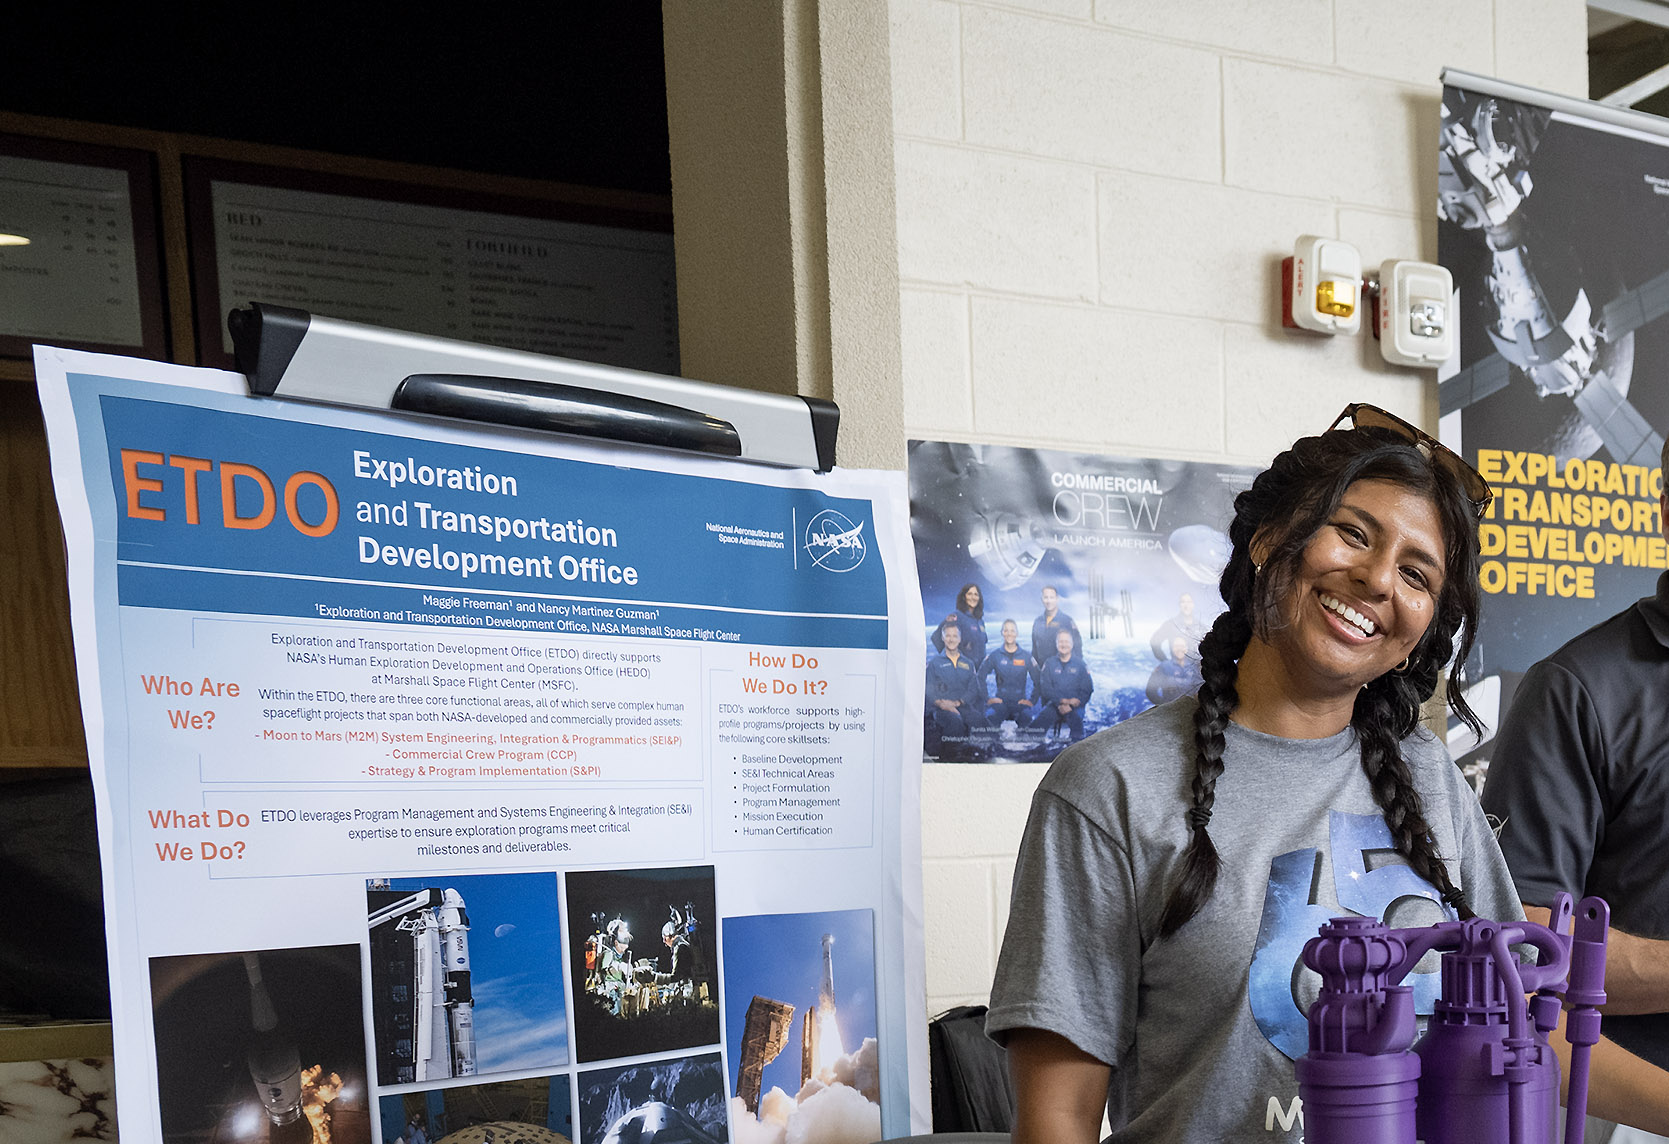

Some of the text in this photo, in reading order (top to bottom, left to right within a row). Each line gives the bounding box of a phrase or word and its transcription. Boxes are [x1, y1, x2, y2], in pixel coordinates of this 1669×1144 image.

[353, 450, 518, 496] Exploration
[1051, 472, 1162, 494] COMMERCIAL
[1478, 449, 1663, 499] EXPLORATIO
[121, 448, 340, 538] ETDO
[1052, 490, 1162, 532] CREW
[1484, 488, 1663, 534] TRANSPORT
[356, 500, 618, 547] and Transportation
[706, 522, 784, 540] National Aeronautics and
[718, 533, 785, 549] Space Administration
[812, 531, 863, 550] NASA
[1054, 534, 1163, 550] LAUNCH AMERICA
[358, 536, 638, 586] Development Office
[1479, 560, 1595, 598] OFFICE
[422, 594, 460, 609] Maggie
[516, 602, 536, 612] and
[537, 602, 570, 616] Nancy
[571, 604, 614, 617] Martinez
[382, 610, 403, 620] and
[404, 611, 483, 625] Transportation
[485, 615, 555, 629] Development
[556, 620, 590, 632] Office,
[591, 622, 620, 634] NASA
[621, 624, 663, 637] Marshall
[663, 626, 692, 641] Space
[693, 628, 715, 643] Flight
[715, 630, 741, 642] Center
[271, 633, 661, 664] Exploration and Transportation Development Office (ETDO) directly supports
[328, 654, 367, 666] Human
[369, 656, 429, 669] Exploration
[432, 659, 503, 672] Development
[506, 663, 525, 672] and
[527, 662, 582, 675] Operations
[584, 665, 613, 676] Office
[615, 667, 650, 679] (HEDO)
[749, 651, 818, 669] How Do
[141, 674, 240, 697] Who Are
[371, 674, 578, 692] at Marshall Space Flight Center (MSFC).
[742, 677, 828, 695] We Do It?
[168, 709, 215, 729] We?
[392, 748, 577, 762] Commercial Crew Program (CCP)
[742, 754, 842, 765] Baseline Development
[368, 765, 601, 778] Strategy & Program Implementation (S&PI)
[742, 768, 834, 778] SE&I Technical Areas
[742, 783, 830, 794] Project Formulation
[742, 797, 840, 808] Program Management
[147, 809, 250, 829] What Do
[742, 811, 823, 821] Mission Execution
[743, 826, 832, 835] Human Certification
[156, 841, 245, 861] We Do?
